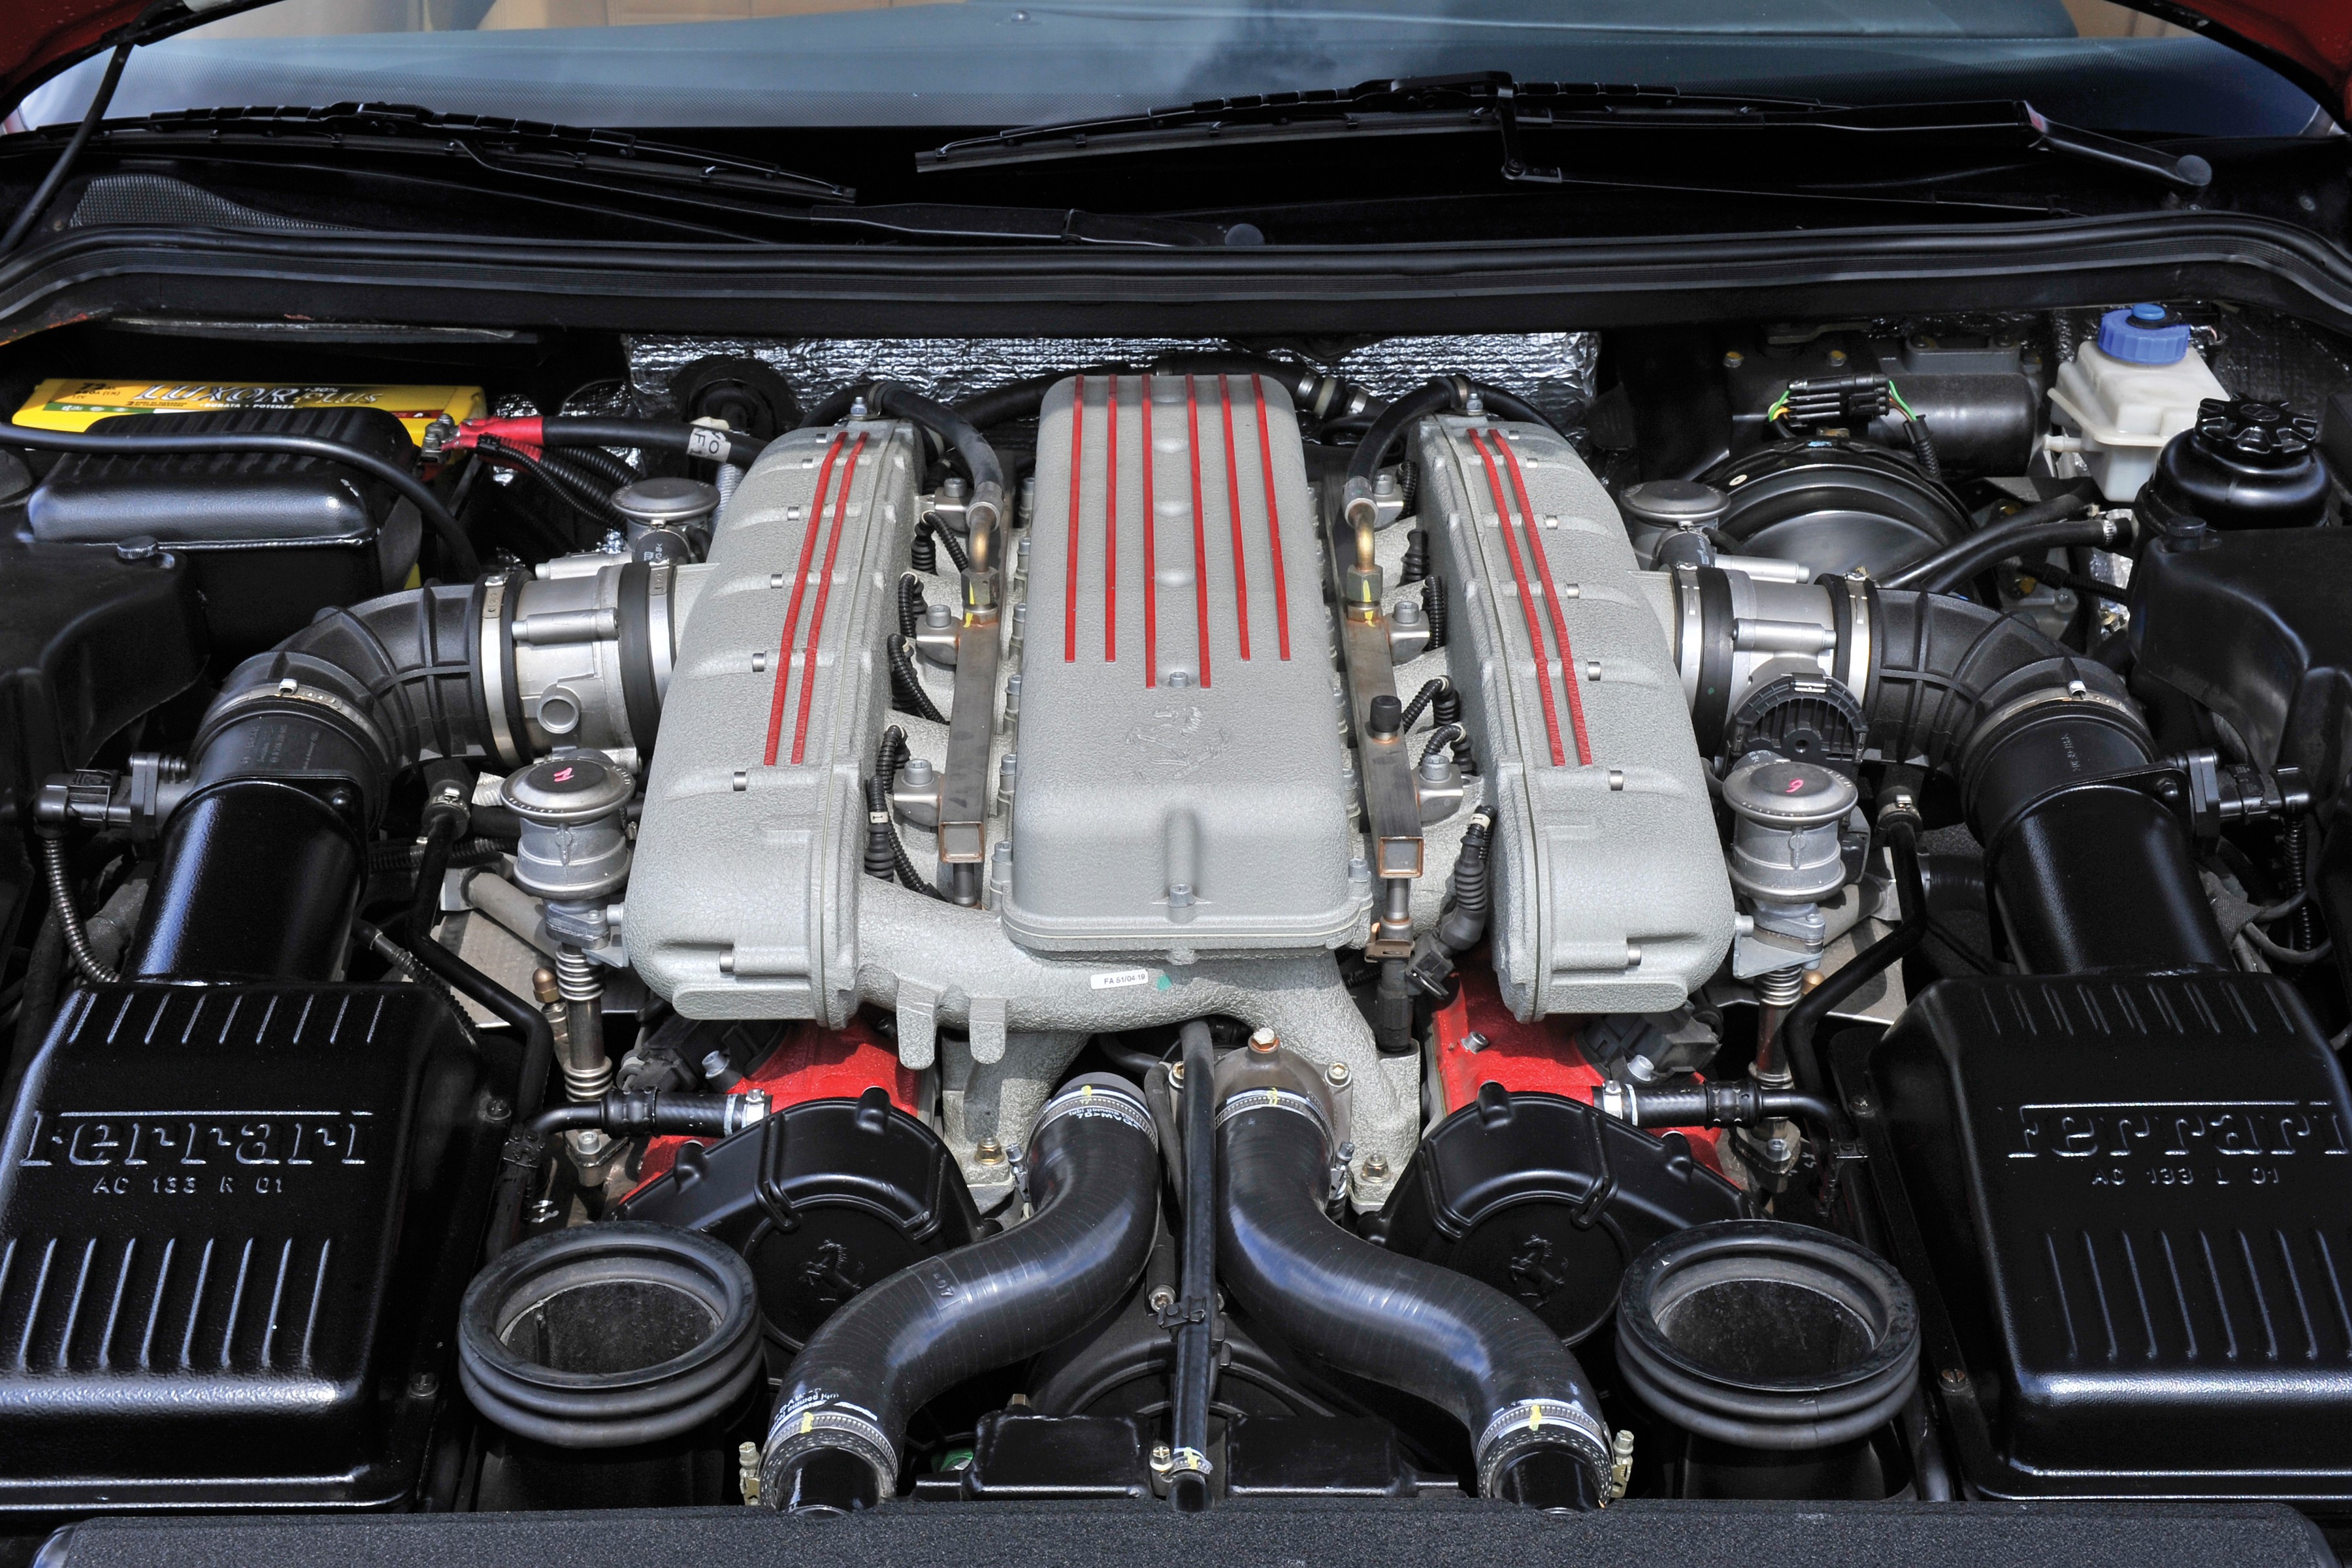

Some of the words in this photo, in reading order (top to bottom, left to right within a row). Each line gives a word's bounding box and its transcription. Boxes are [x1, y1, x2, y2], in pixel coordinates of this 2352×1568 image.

[133, 385, 301, 402] LUXOR
[293, 392, 384, 404] PLUS
[20, 1111, 374, 1166] Ferrari
[2008, 1101, 2350, 1158] Ferrari
[93, 1177, 129, 1194] AC
